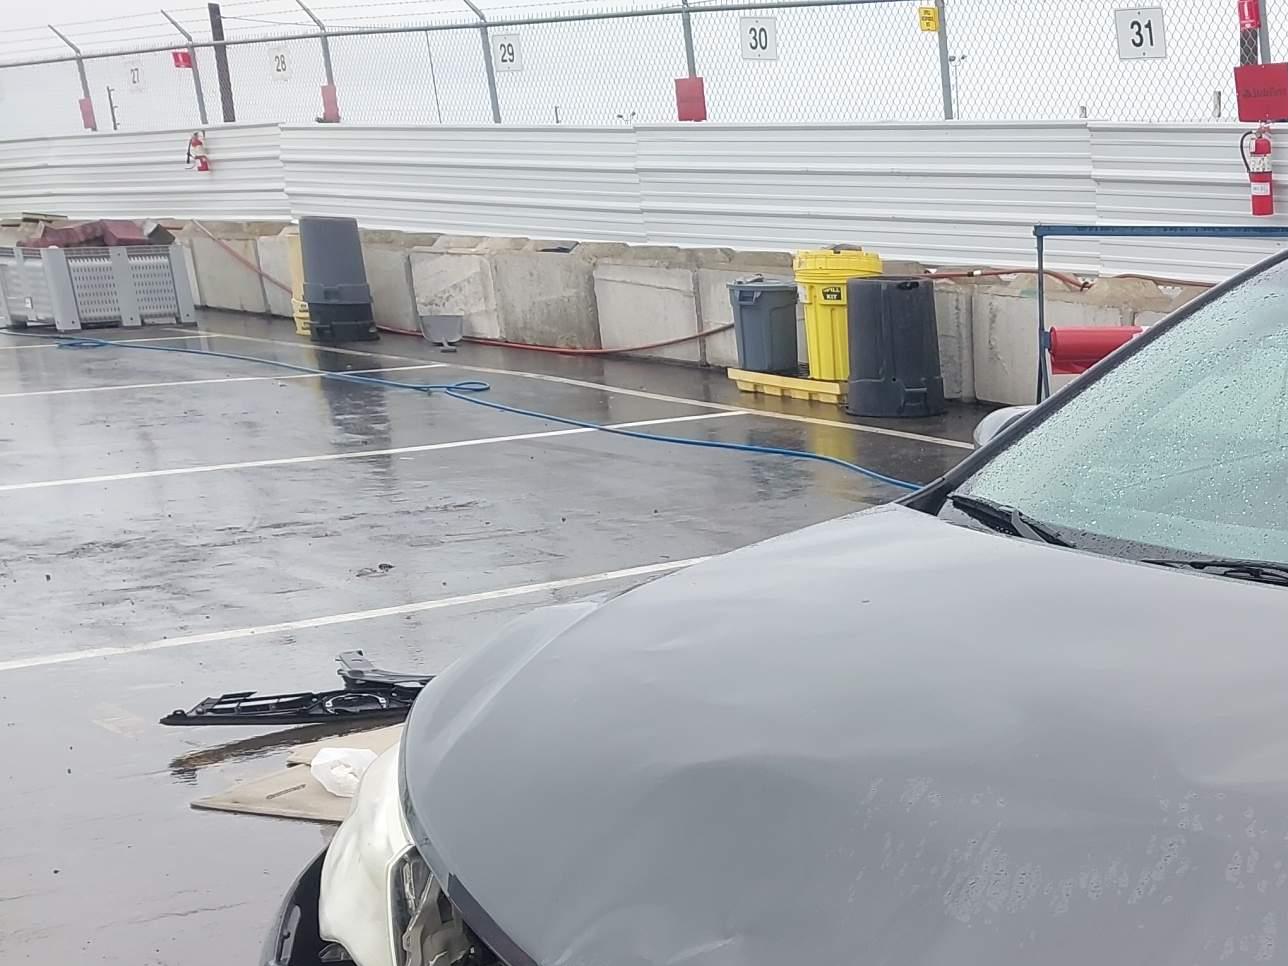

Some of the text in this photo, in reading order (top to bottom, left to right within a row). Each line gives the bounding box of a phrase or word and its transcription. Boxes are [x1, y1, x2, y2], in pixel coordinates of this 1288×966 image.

[749, 27, 768, 50] 30
[1130, 19, 1154, 47] 31
[274, 54, 287, 72] 28
[499, 43, 515, 63] 29
[130, 67, 140, 84] 27
